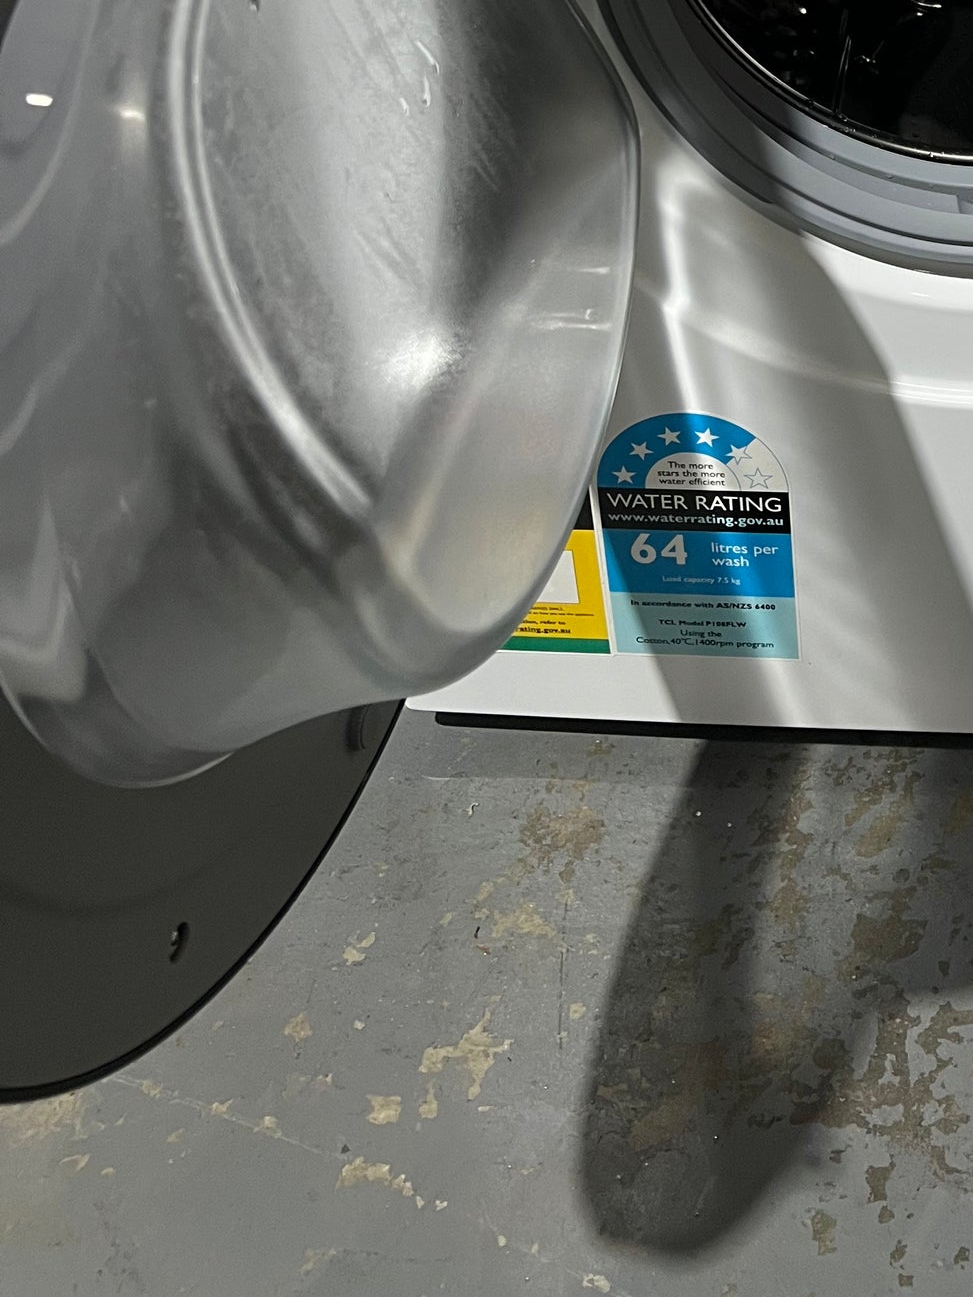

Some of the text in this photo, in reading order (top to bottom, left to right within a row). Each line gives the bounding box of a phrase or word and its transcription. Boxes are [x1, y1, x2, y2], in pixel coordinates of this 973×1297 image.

[667, 460, 714, 470] The more
[657, 469, 726, 479] stars the more
[658, 478, 726, 487] water efficient
[606, 492, 782, 513] WATER RATING
[608, 513, 784, 528] www.waterrating.gov.au
[630, 532, 779, 566] 64 litres per
[712, 555, 750, 568] wash
[717, 576, 729, 584] 7.5
[731, 577, 741, 586] kg
[641, 600, 692, 608] accordance
[694, 601, 714, 609] with
[716, 602, 752, 610] AS/NZS
[754, 603, 776, 611] 6400
[658, 618, 676, 626] TCL
[680, 629, 722, 638] Using the
[736, 641, 775, 650] program
